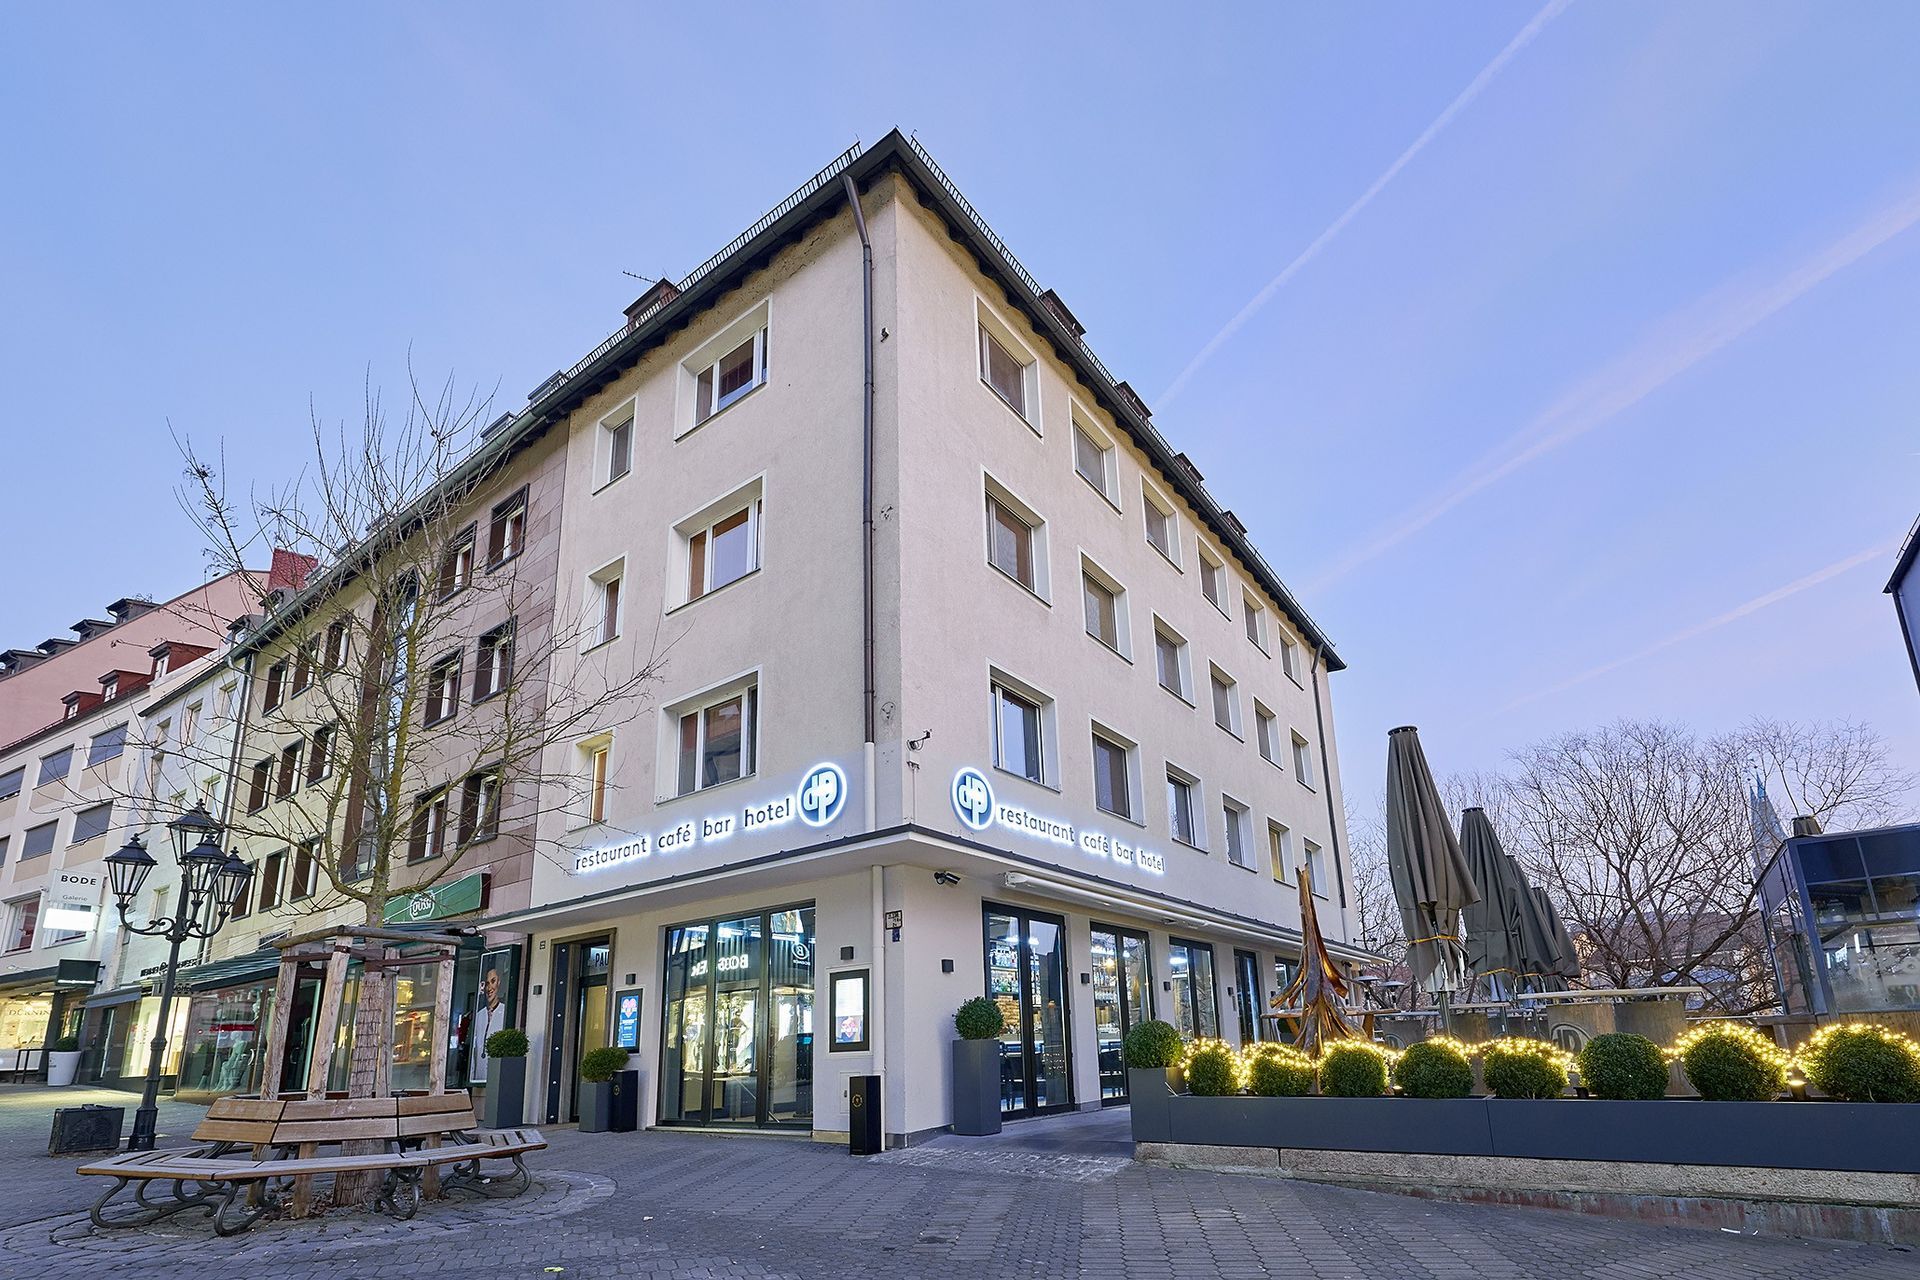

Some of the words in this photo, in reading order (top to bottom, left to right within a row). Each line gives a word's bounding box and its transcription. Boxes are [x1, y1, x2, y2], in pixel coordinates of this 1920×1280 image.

[575, 838, 647, 870] restaurant
[658, 824, 691, 848] café
[703, 817, 731, 838] bar
[744, 798, 790, 827] hotel
[1000, 806, 1075, 842] restaurant
[1083, 833, 1109, 853] café
[1115, 842, 1134, 861] bar
[1140, 850, 1165, 872] hotel
[61, 875, 97, 885] BODE
